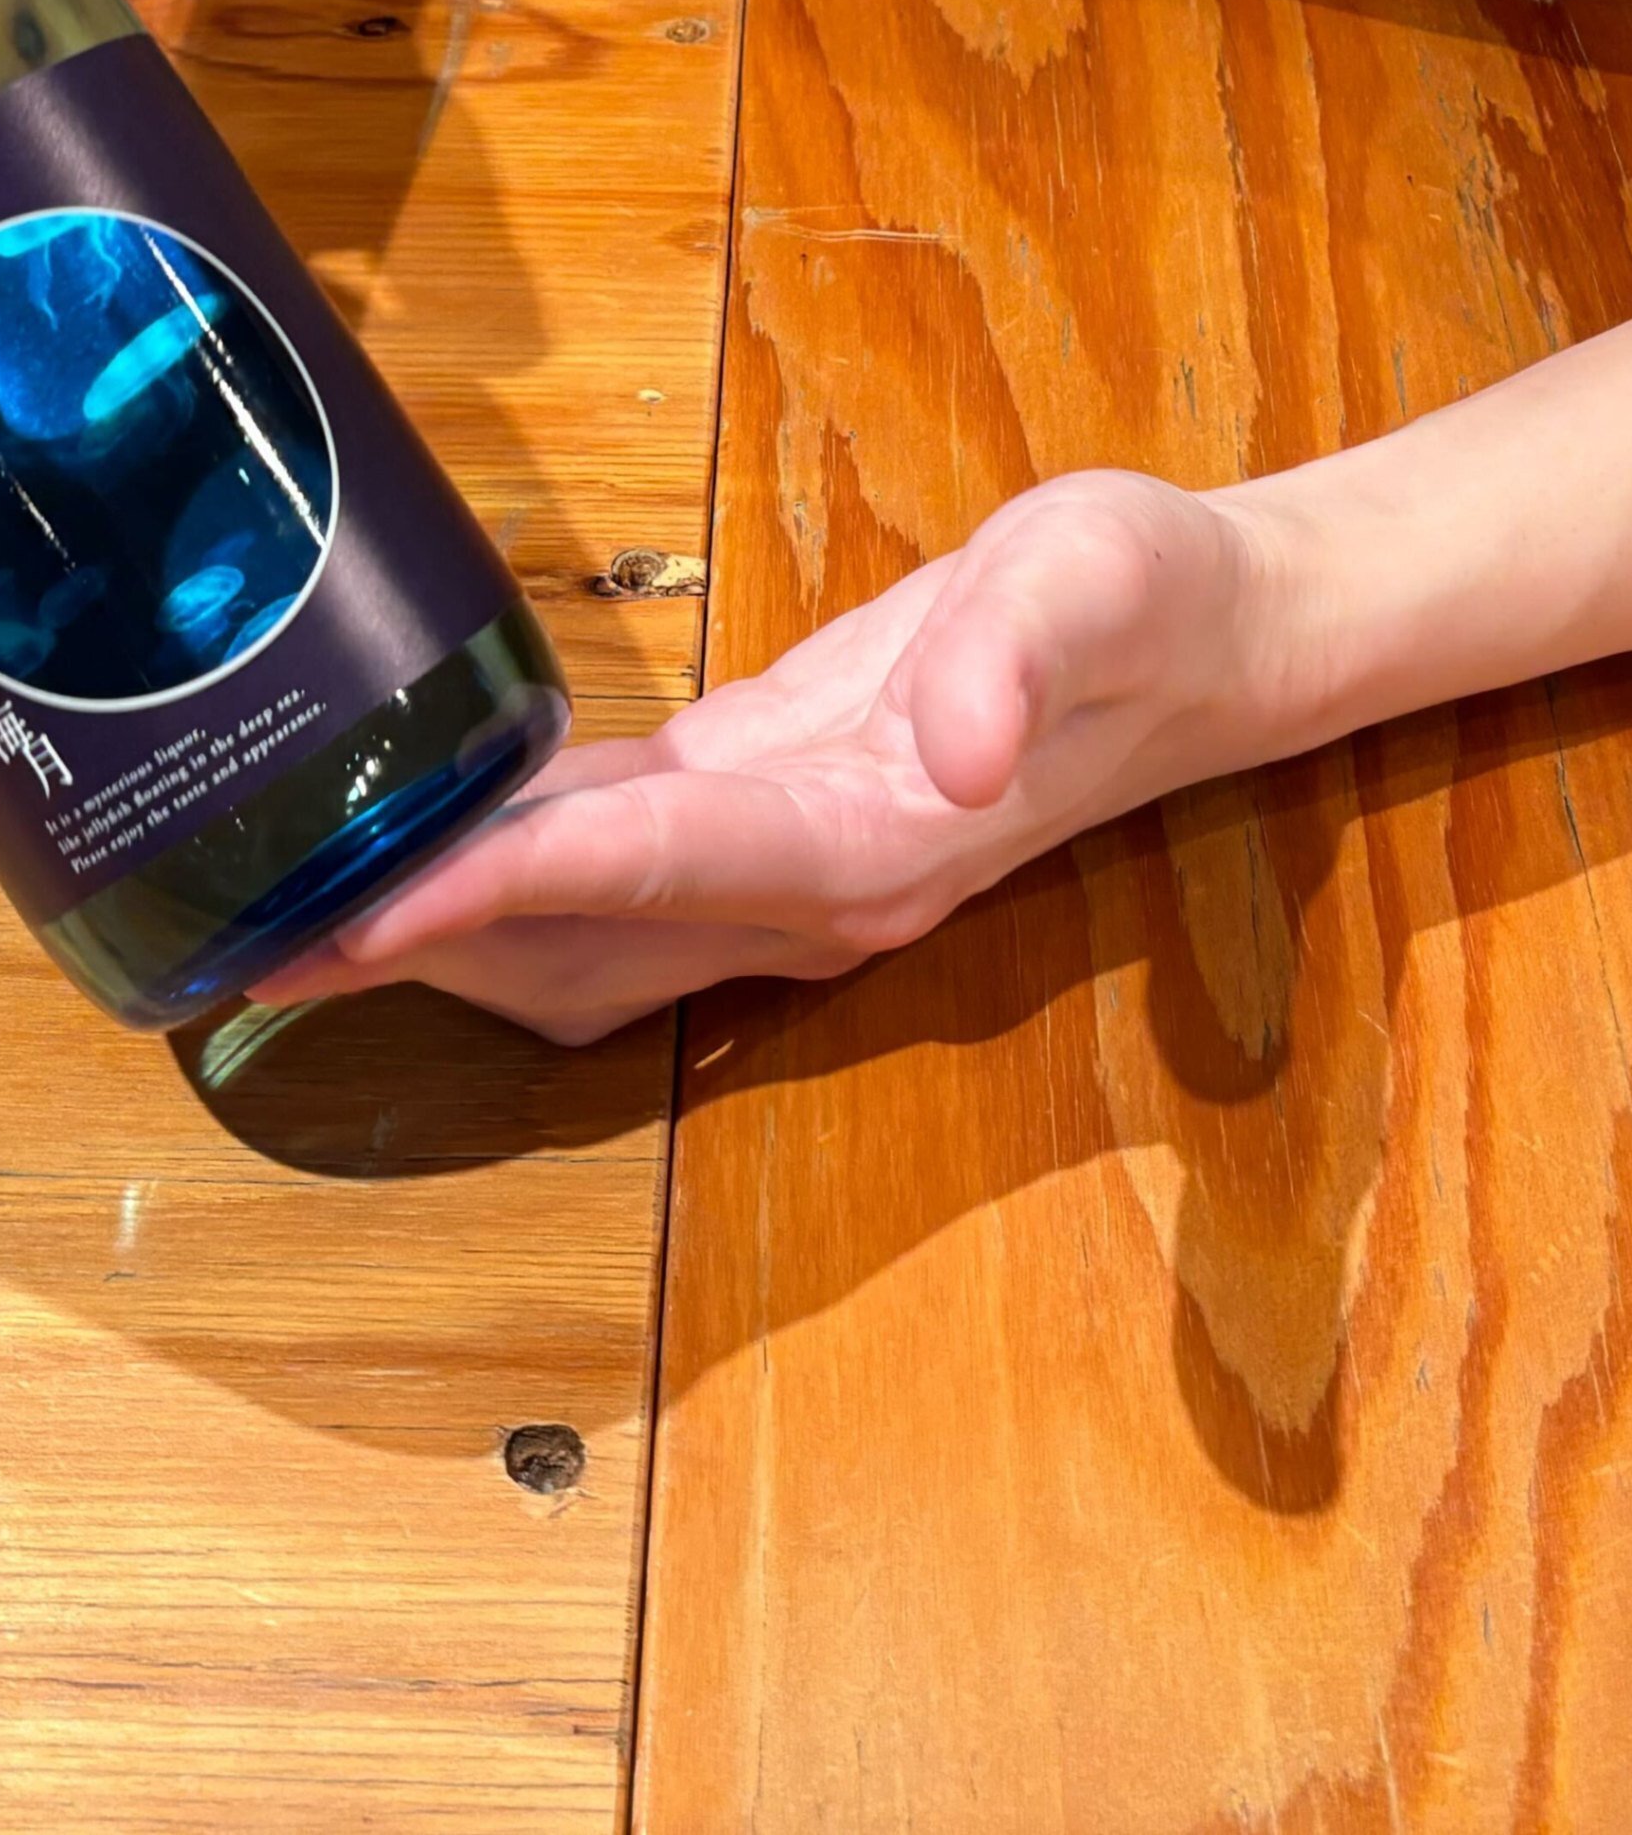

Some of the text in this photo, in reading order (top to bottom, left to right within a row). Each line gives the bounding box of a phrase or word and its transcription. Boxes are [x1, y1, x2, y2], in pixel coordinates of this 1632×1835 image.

[45, 820, 59, 835] It
[61, 813, 72, 828] is
[73, 808, 82, 820] a
[83, 762, 153, 811] mysterious
[57, 835, 81, 855] like
[83, 801, 132, 844] jellyfish
[133, 766, 189, 808] floating
[189, 753, 207, 771] in
[210, 734, 235, 756] the
[238, 708, 273, 739] deep
[70, 845, 108, 874] Please
[110, 822, 145, 852] enjoy
[147, 806, 170, 828] the
[173, 780, 208, 810] taste
[212, 757, 238, 785] and
